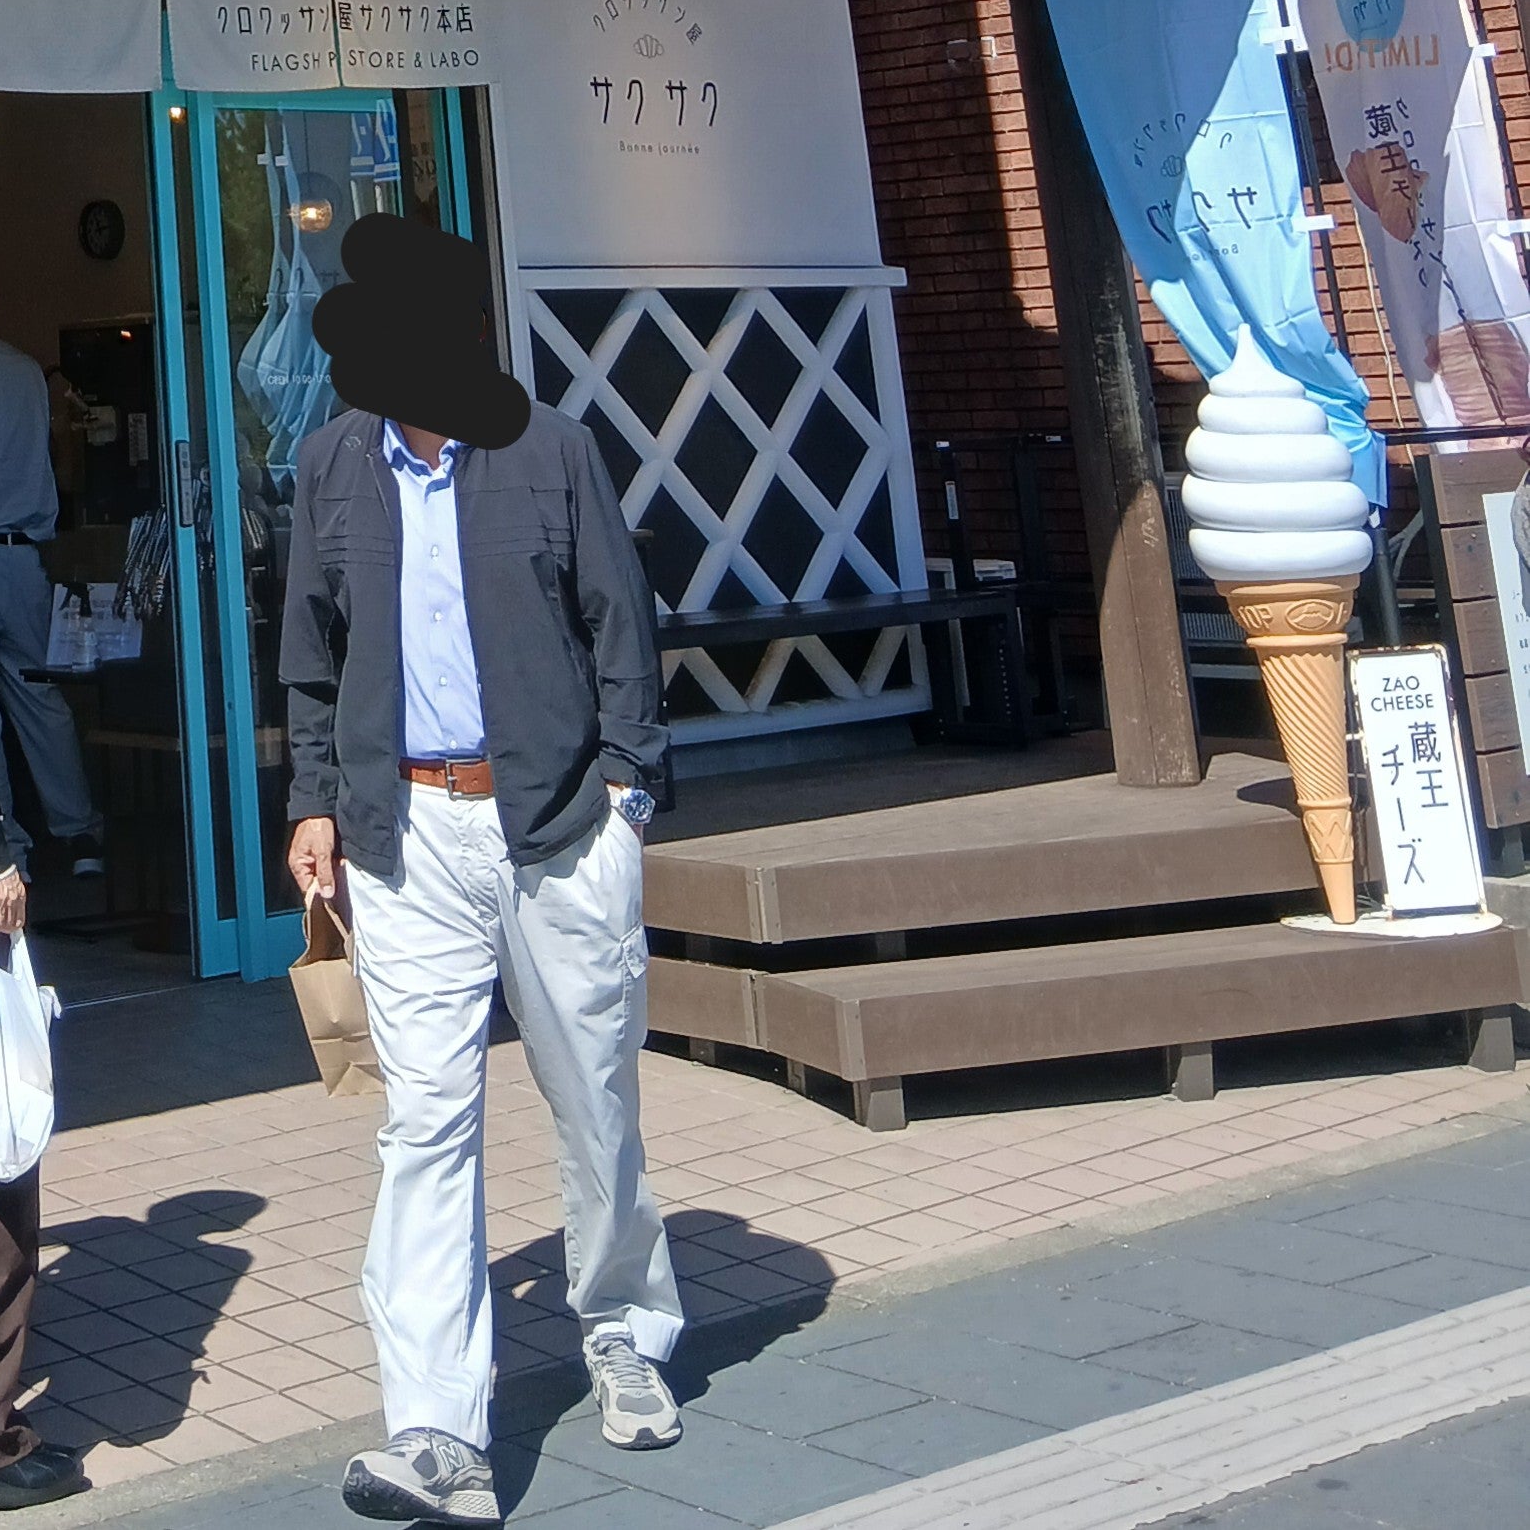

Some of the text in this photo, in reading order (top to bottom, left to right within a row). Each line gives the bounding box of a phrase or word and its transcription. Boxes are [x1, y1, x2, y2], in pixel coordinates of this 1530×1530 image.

[251, 49, 479, 72] FLAGSHP STORE & LABO
[589, 76, 718, 127] サクサク
[1370, 693, 1434, 711] CHEESE
[1382, 676, 1420, 692] ZAO
[1408, 721, 1449, 810] 蔵王
[1381, 744, 1426, 886] チーズ
